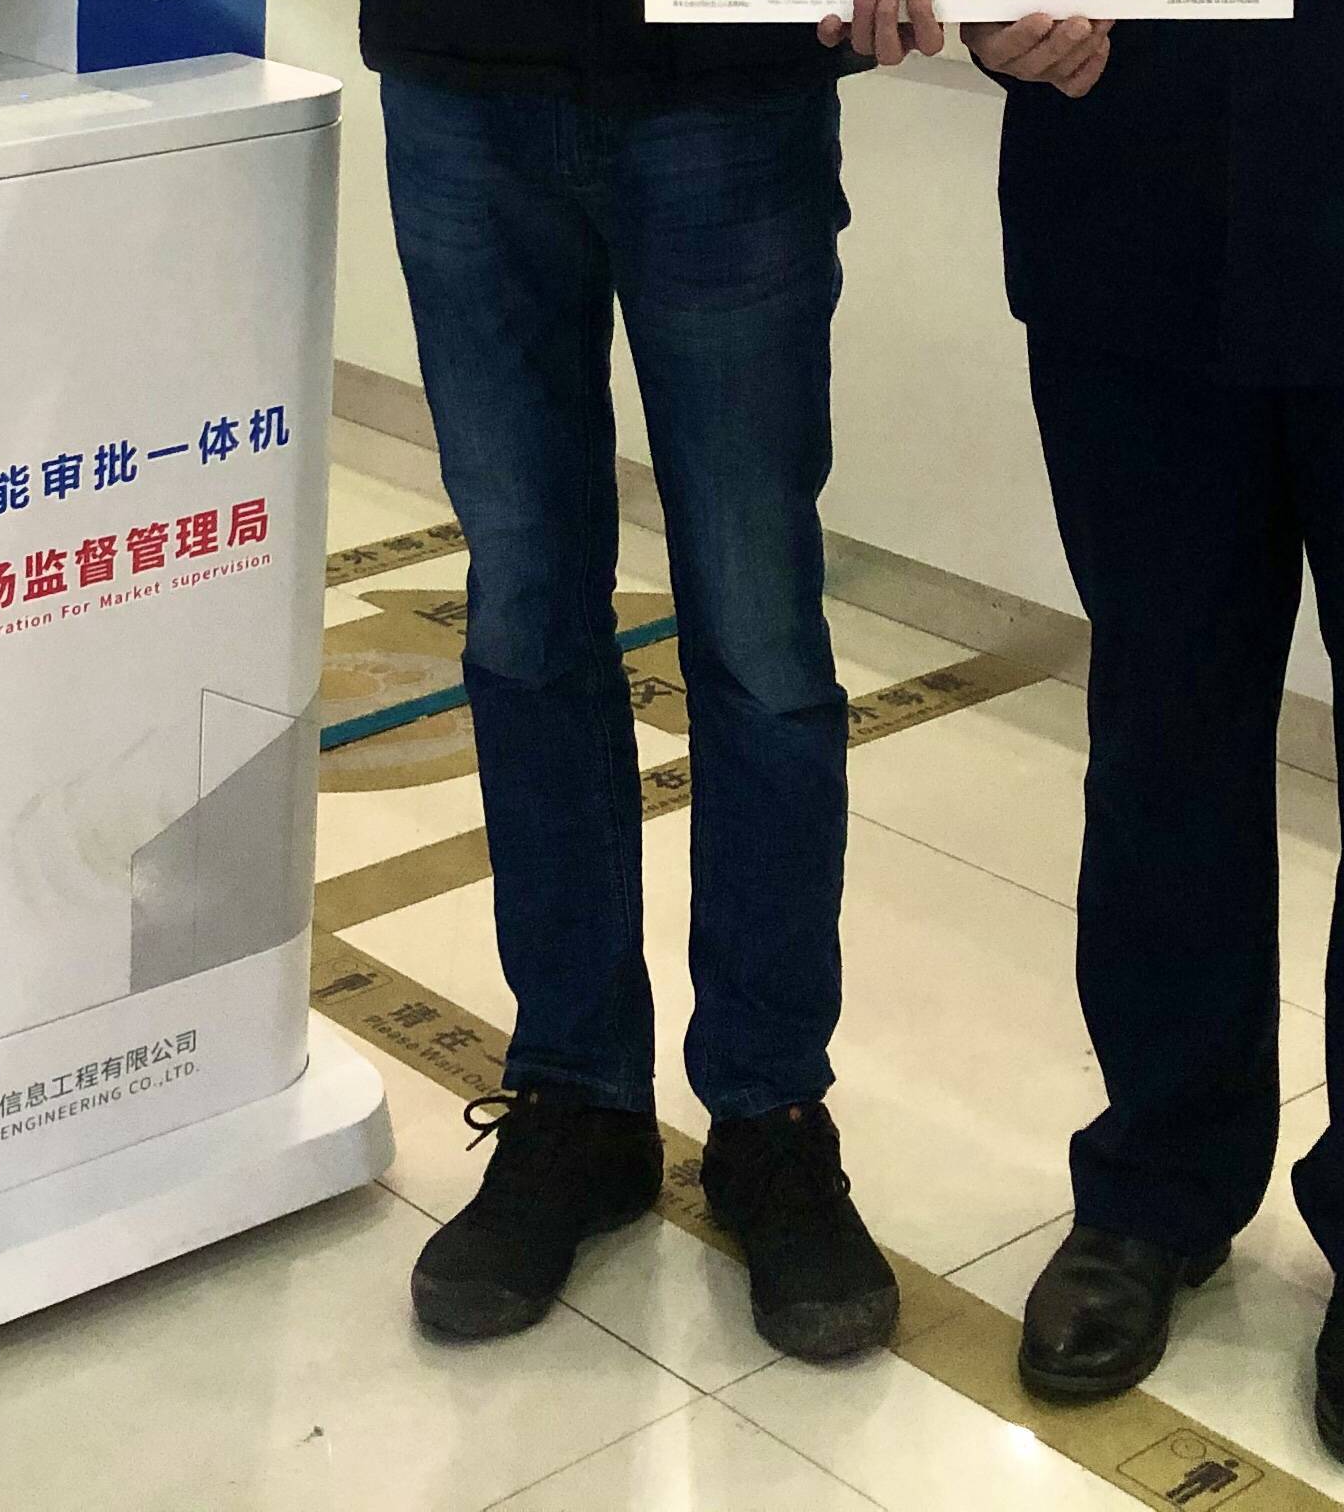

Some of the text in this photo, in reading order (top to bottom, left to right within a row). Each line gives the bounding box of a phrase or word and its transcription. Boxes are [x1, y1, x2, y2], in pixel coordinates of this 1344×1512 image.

[61, 601, 91, 618] For
[100, 582, 161, 608] Market
[171, 554, 271, 588] supervision
[0, 1085, 123, 1140] ENGINEERING
[128, 1061, 201, 1095] CO.,LTD.
